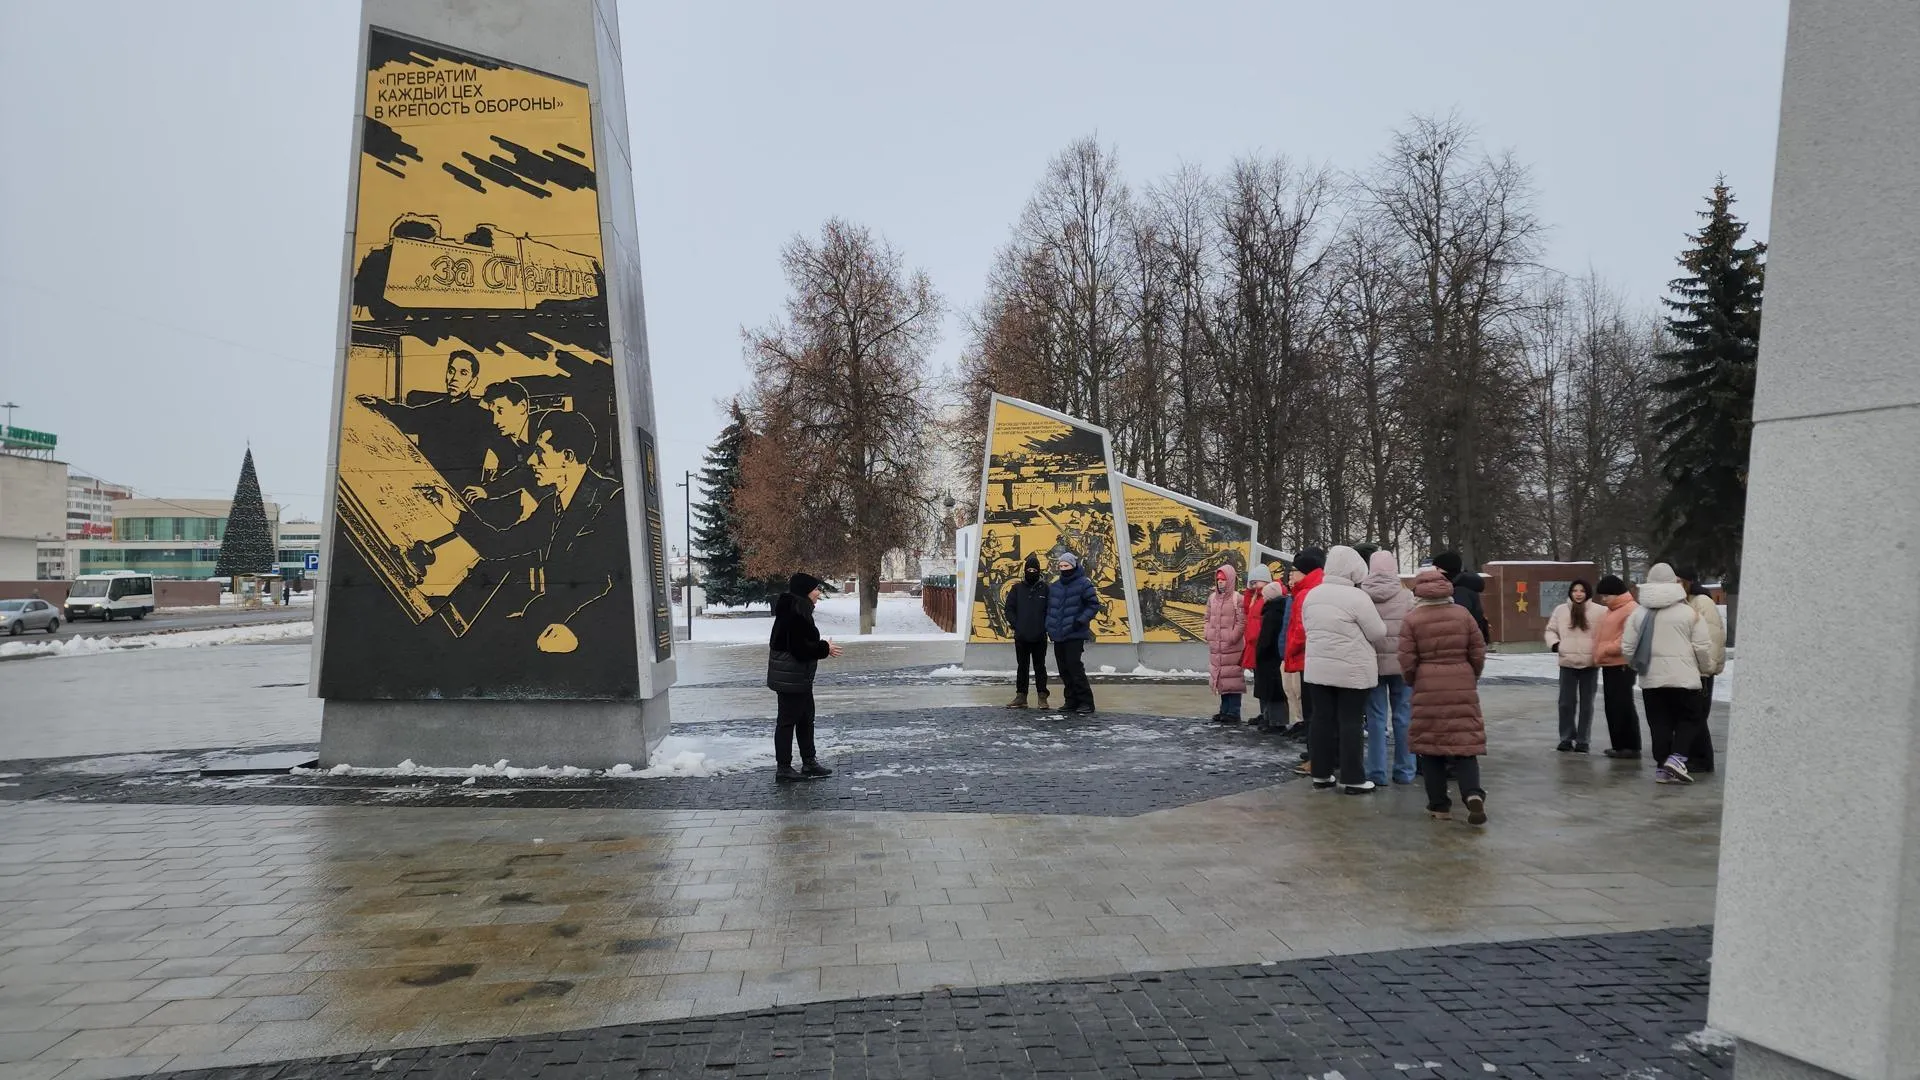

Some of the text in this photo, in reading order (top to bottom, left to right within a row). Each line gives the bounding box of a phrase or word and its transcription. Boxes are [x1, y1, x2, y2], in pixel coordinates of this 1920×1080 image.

[378, 69, 477, 86] «ПРЕВРАТИМ
[378, 83, 483, 103] КАЖДЫЙ ЦЕХ
[374, 96, 564, 119] В КРЕПОСТЬ ОБОРОНЫ»
[482, 256, 599, 297] Сталина
